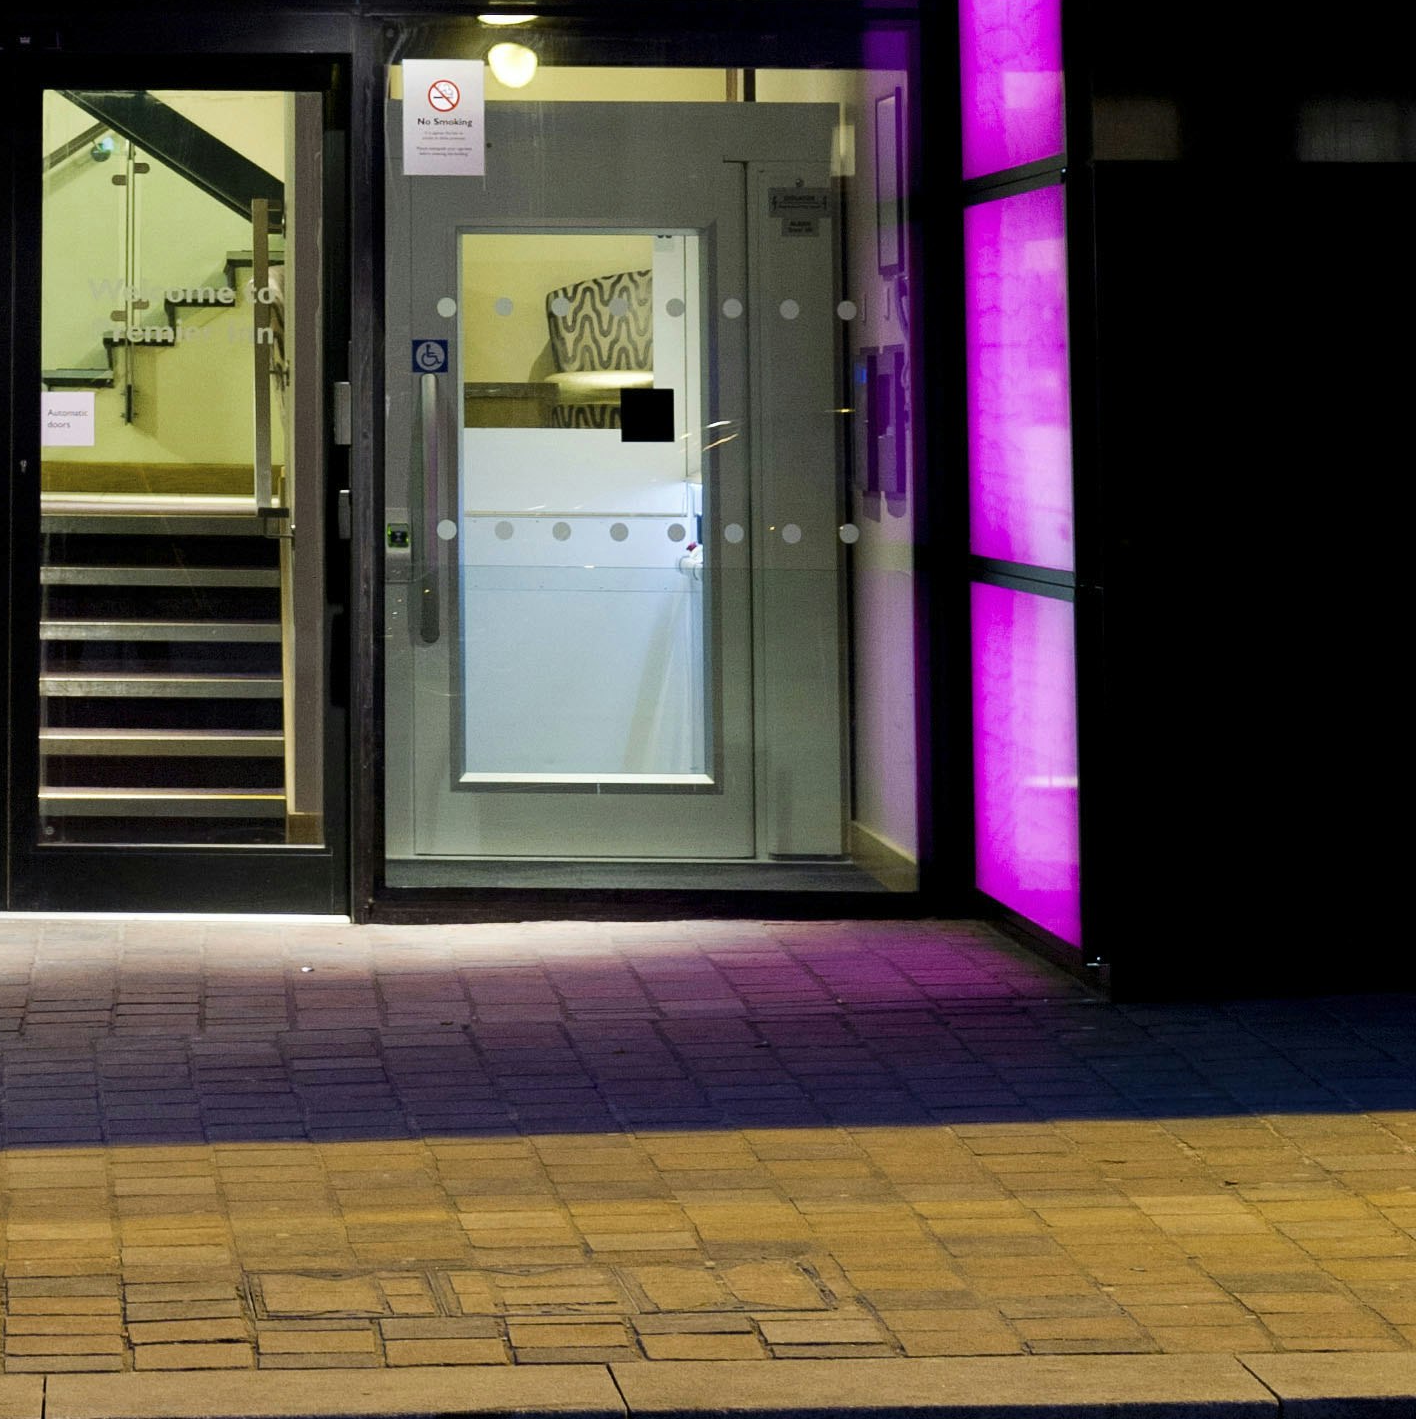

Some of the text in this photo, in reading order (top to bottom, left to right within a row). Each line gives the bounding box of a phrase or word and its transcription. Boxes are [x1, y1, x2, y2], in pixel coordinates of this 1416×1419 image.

[417, 117, 473, 128] No Smoking
[247, 278, 276, 304] to
[47, 409, 89, 417] Automatic
